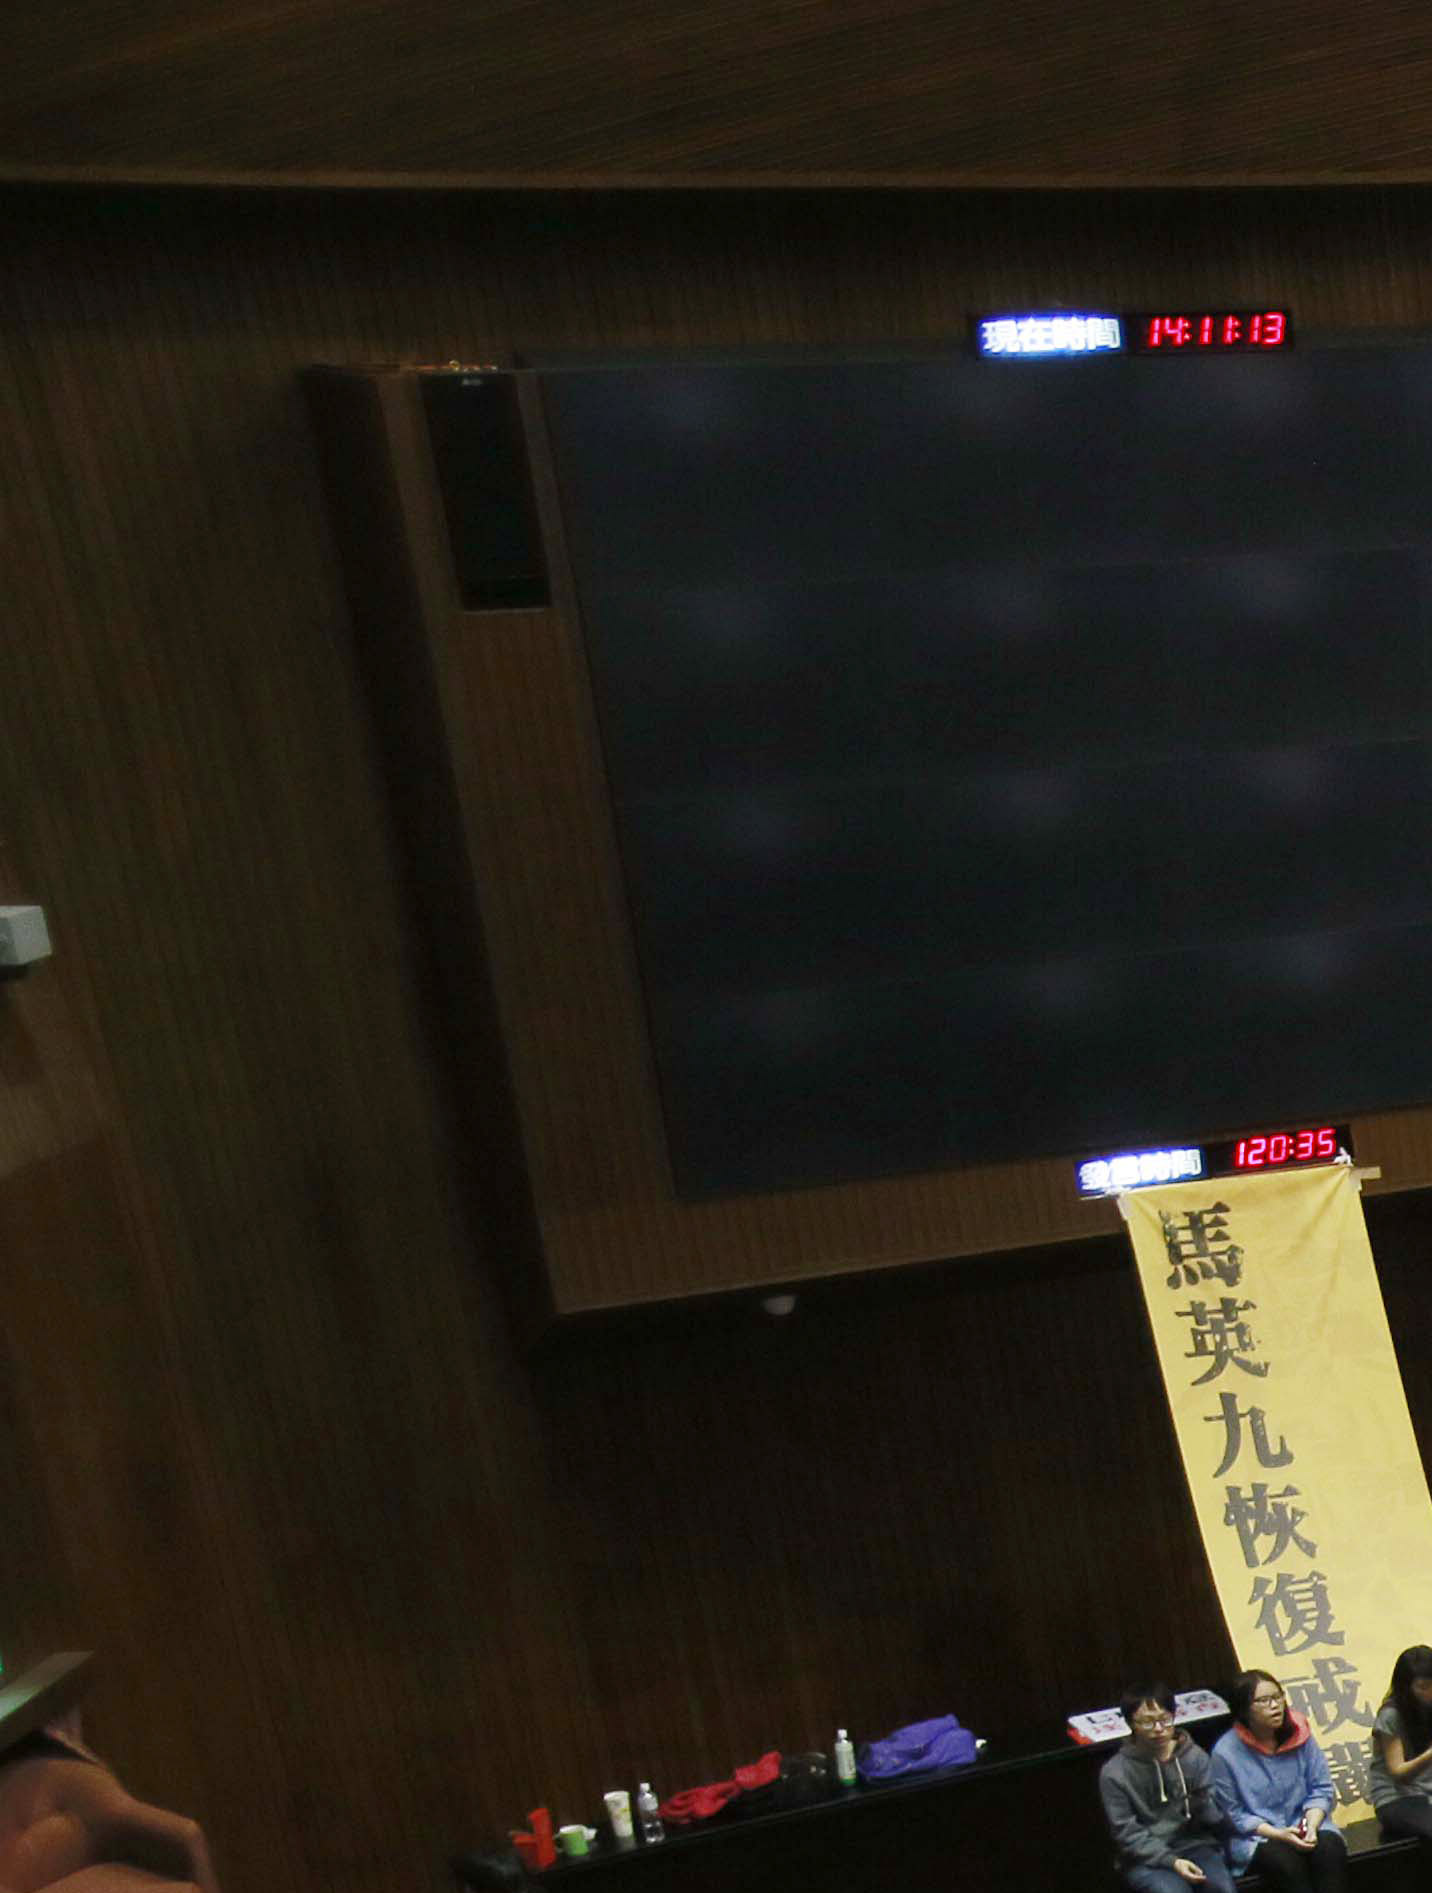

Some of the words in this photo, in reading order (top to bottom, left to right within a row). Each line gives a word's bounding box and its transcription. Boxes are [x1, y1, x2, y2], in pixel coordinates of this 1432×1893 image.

[981, 317, 1121, 354] 現在時間
[1149, 311, 1287, 347] 14:11:13
[1236, 1128, 1336, 1168] 120:35
